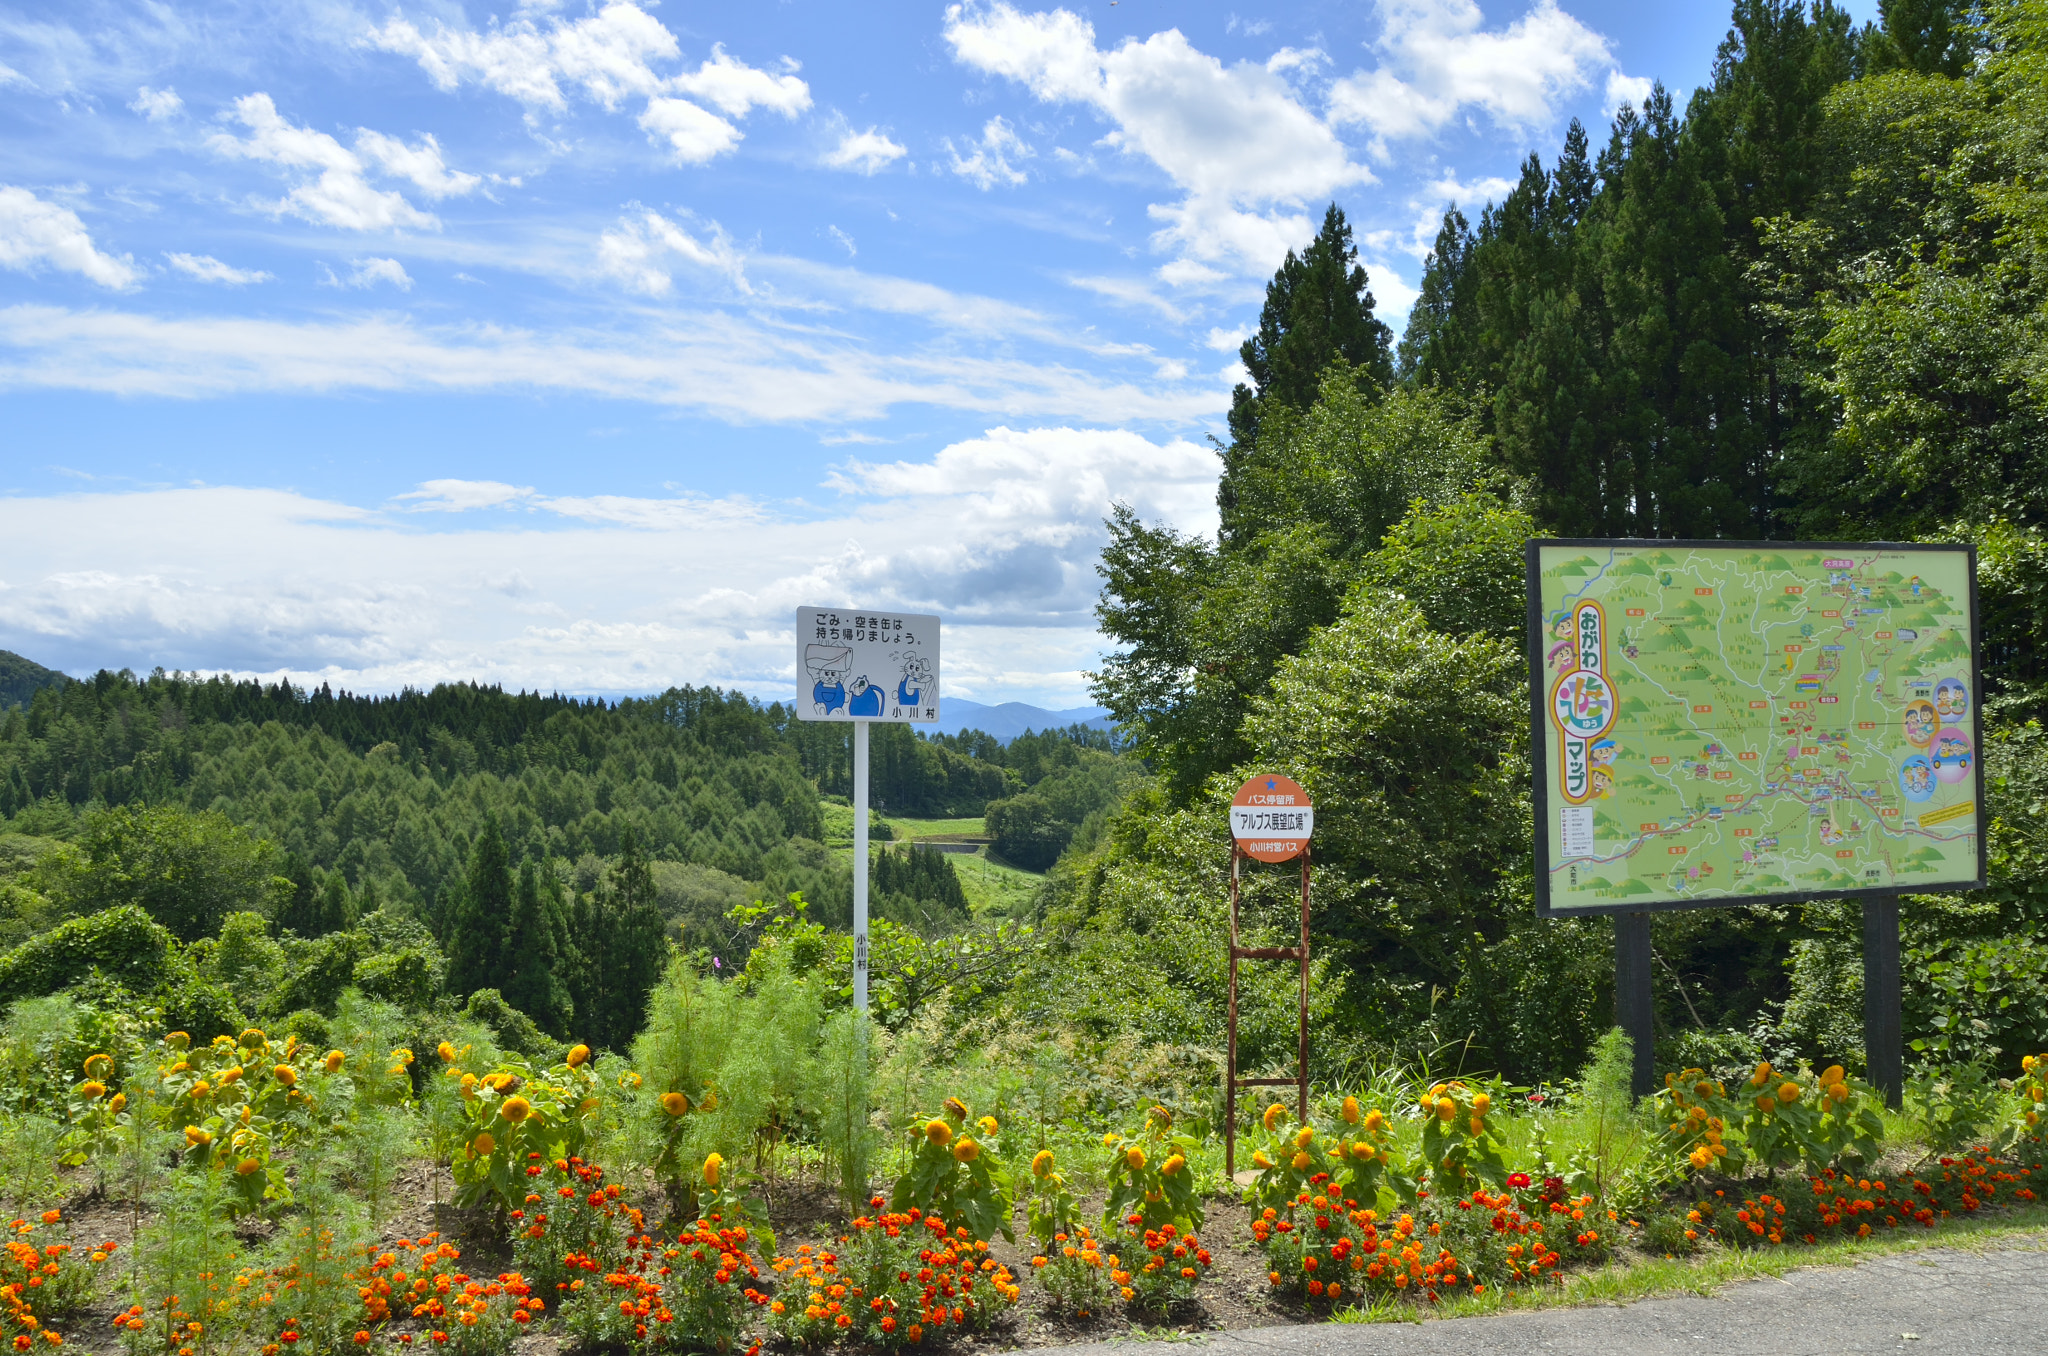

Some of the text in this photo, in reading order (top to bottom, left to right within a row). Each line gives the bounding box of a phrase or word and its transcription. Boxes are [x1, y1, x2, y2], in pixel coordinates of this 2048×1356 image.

[816, 613, 902, 631] ごみ・空き缶は
[816, 626, 921, 645] 持ち帰りましょう。
[1581, 611, 1599, 668] おがわ
[892, 707, 935, 719] 小川村
[1582, 719, 1598, 729] ゆう
[1567, 741, 1586, 792] マップ
[1248, 794, 1295, 805] バス停留所
[1240, 812, 1304, 831] アルプス展望広場
[1249, 841, 1298, 852] 小川村営バス
[856, 934, 867, 970] 小川村
